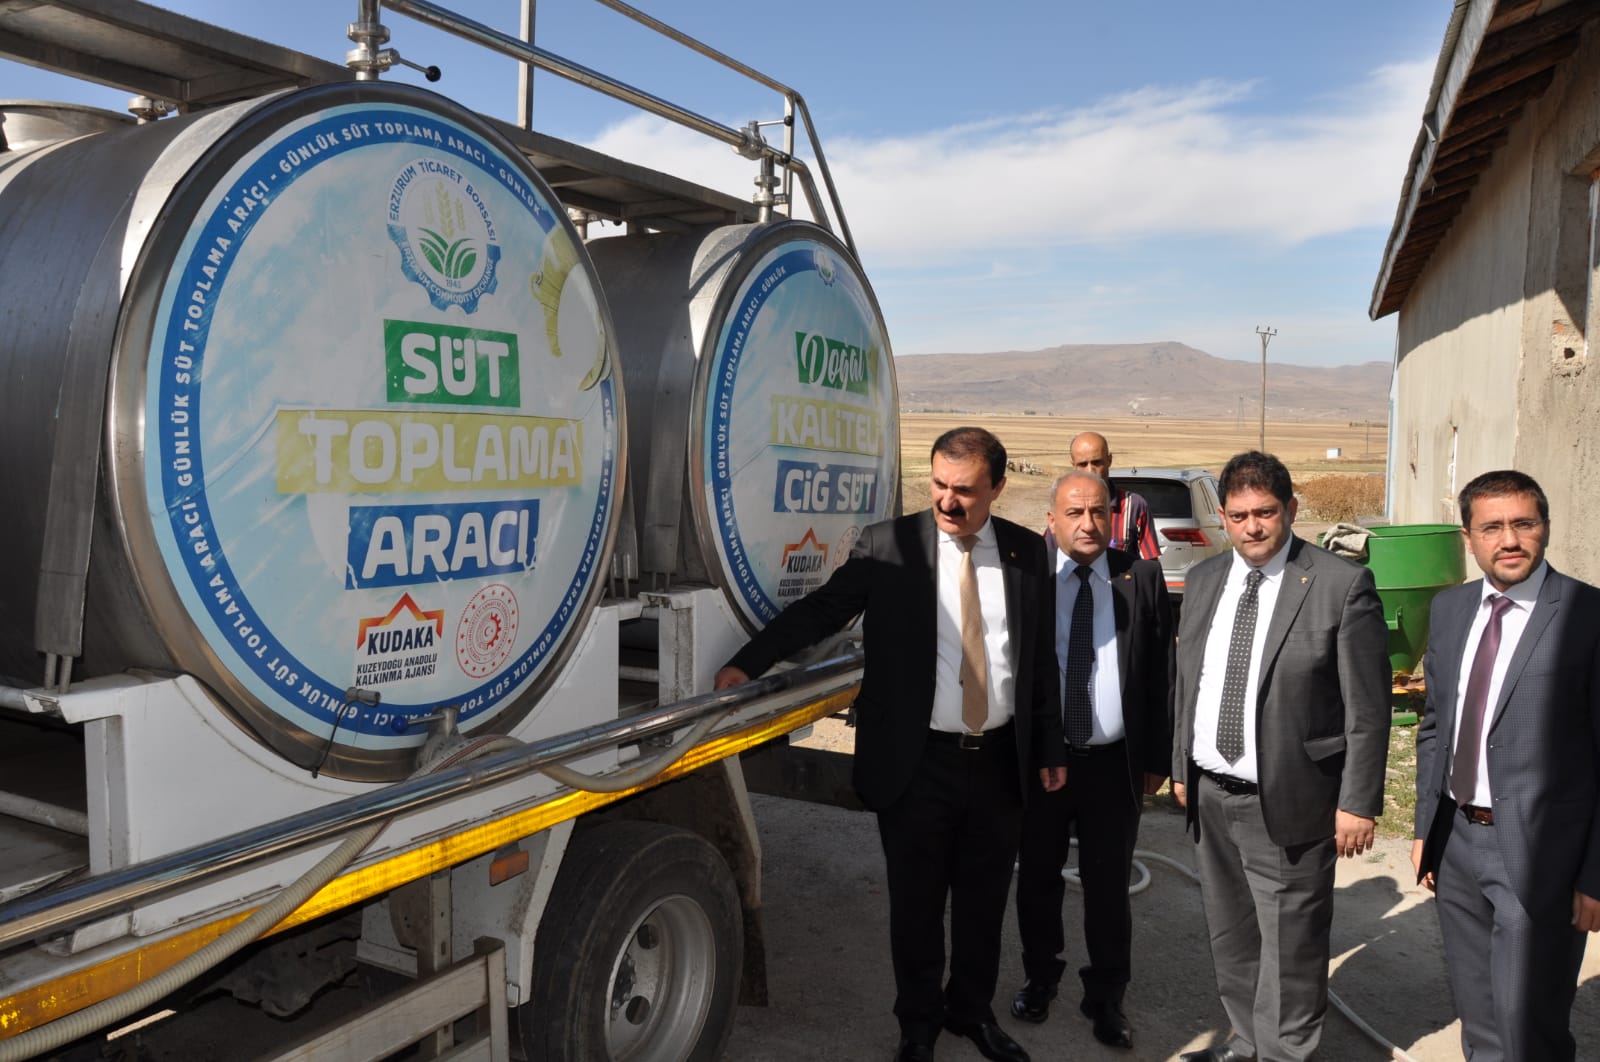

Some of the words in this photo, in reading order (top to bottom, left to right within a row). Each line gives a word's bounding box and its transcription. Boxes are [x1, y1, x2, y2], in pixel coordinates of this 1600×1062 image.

[279, 132, 340, 173] GÜNLÜK
[341, 122, 371, 141] SÜT
[375, 122, 443, 143] TOPLAMA
[448, 136, 486, 164] ARACI
[389, 165, 417, 222] ERZURUM
[418, 158, 463, 185] TİCARET
[465, 184, 496, 241] BORSASI
[499, 167, 541, 215] GÜNLÜK
[184, 236, 232, 331] TOPLAMA
[174, 340, 195, 385] SÜT
[400, 332, 510, 398] SÜT
[719, 392, 729, 419] SÜT
[724, 331, 744, 388] TOPLAMA
[741, 297, 759, 329] ARACI
[800, 330, 865, 395] Doğal
[171, 394, 193, 487] GÜNLÜK
[299, 417, 576, 485] TOPLAMA
[836, 471, 876, 512] SÜT
[182, 502, 216, 570] ARACI
[361, 509, 530, 580] ARACI
[728, 531, 750, 585] TOPLAMA
[786, 554, 823, 574] KUDAKA
[209, 572, 268, 659] TOPLAMA
[559, 577, 582, 621] ARACI
[367, 625, 434, 656] KUDAKA
[403, 653, 438, 668] ANADOLU
[267, 656, 299, 687] SÜT
[355, 669, 402, 687] KALKINMA
[404, 663, 436, 680] AJANSI
[487, 675, 510, 700] SÜT
